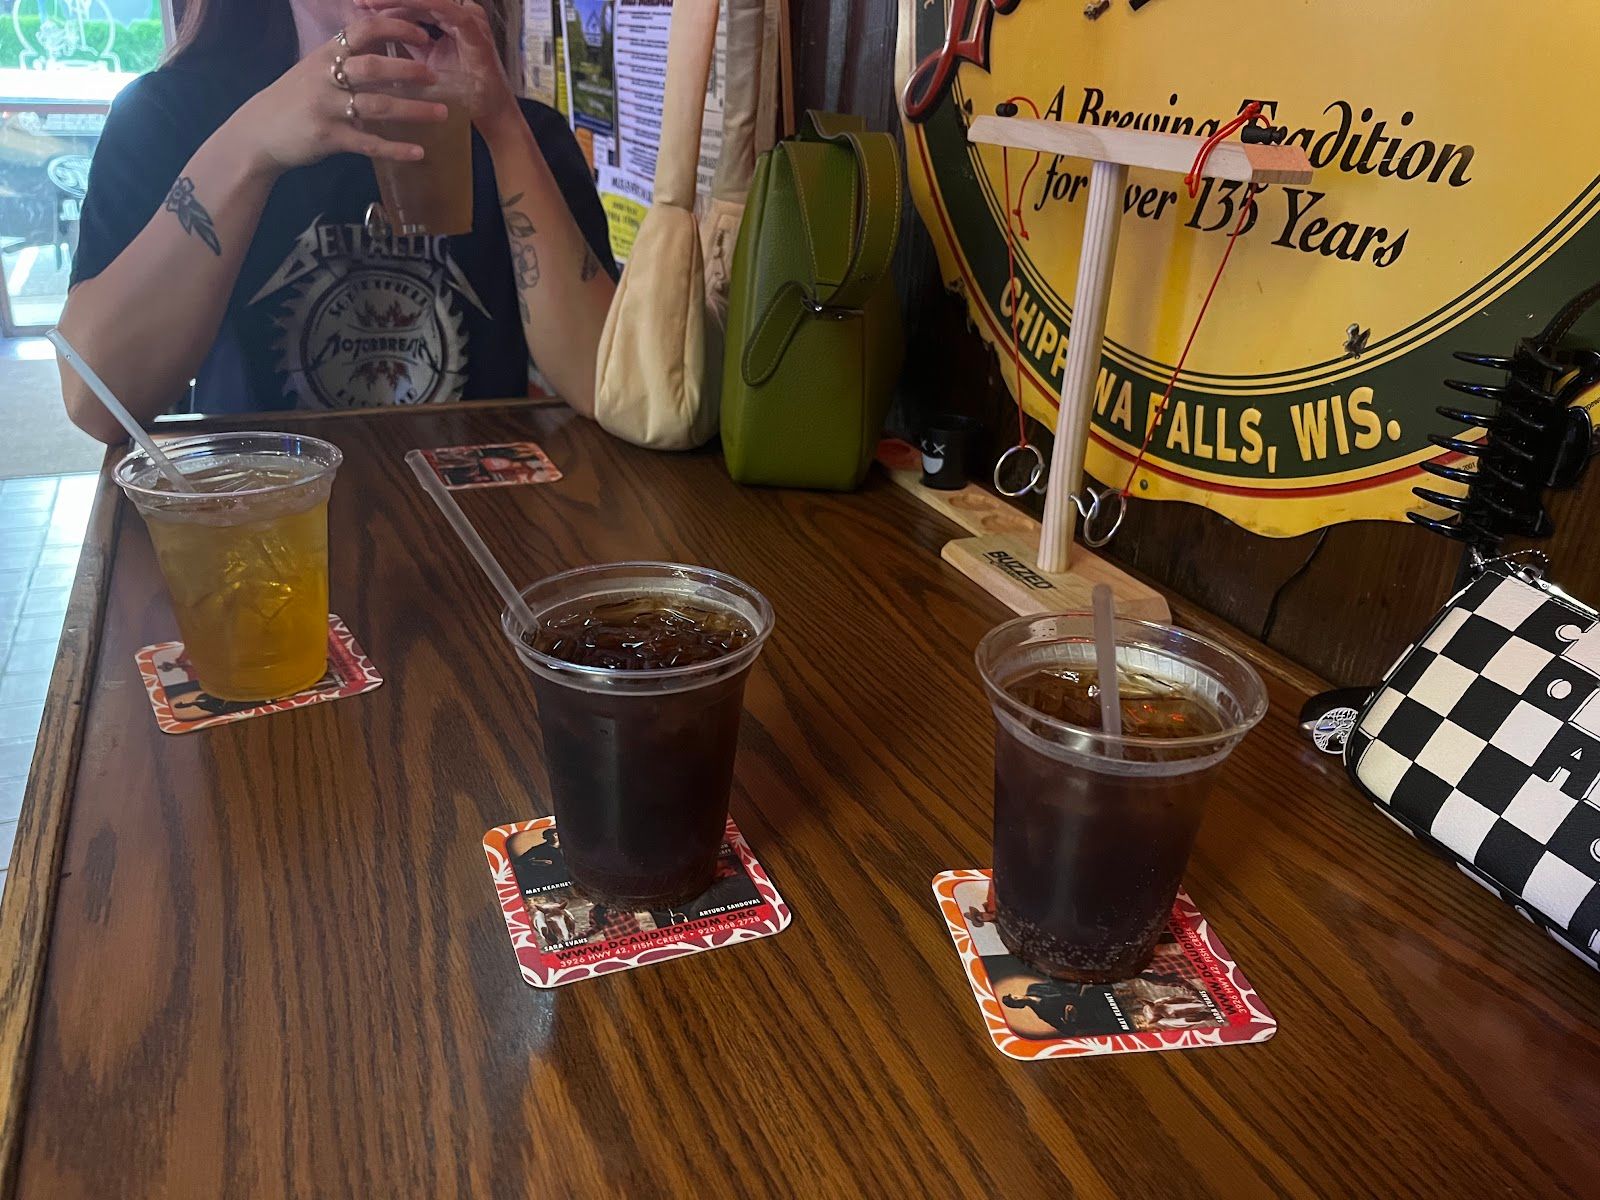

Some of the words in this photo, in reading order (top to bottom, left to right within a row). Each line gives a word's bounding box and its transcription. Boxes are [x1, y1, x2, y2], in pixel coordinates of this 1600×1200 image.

[1044, 84, 1065, 121] A
[1034, 154, 1088, 212] for
[1123, 182, 1177, 221] ver
[1184, 175, 1269, 237] 135
[1271, 186, 1409, 268] Years
[1000, 276, 1132, 433] CHIPPWA
[1145, 391, 1277, 474] FALLS,
[1289, 386, 1401, 463] WIS.
[987, 550, 1055, 589] BUZZED
[525, 887, 541, 895] MAT
[699, 906, 725, 917] ARTURO
[726, 898, 761, 910] SANDOVAL
[556, 909, 758, 961] WWW.DCAUDITORIUM.ORG
[543, 943, 564, 952] SARA
[564, 938, 588, 947] EVANS
[560, 957, 585, 968] 3926
[588, 951, 611, 961] HWY
[632, 941, 654, 950] FISH
[657, 932, 686, 945] CREEK
[1198, 948, 1213, 963] FISH
[1218, 976, 1233, 994] HWY
[1231, 995, 1247, 1014] 3926
[1211, 1008, 1225, 1023] SARA
